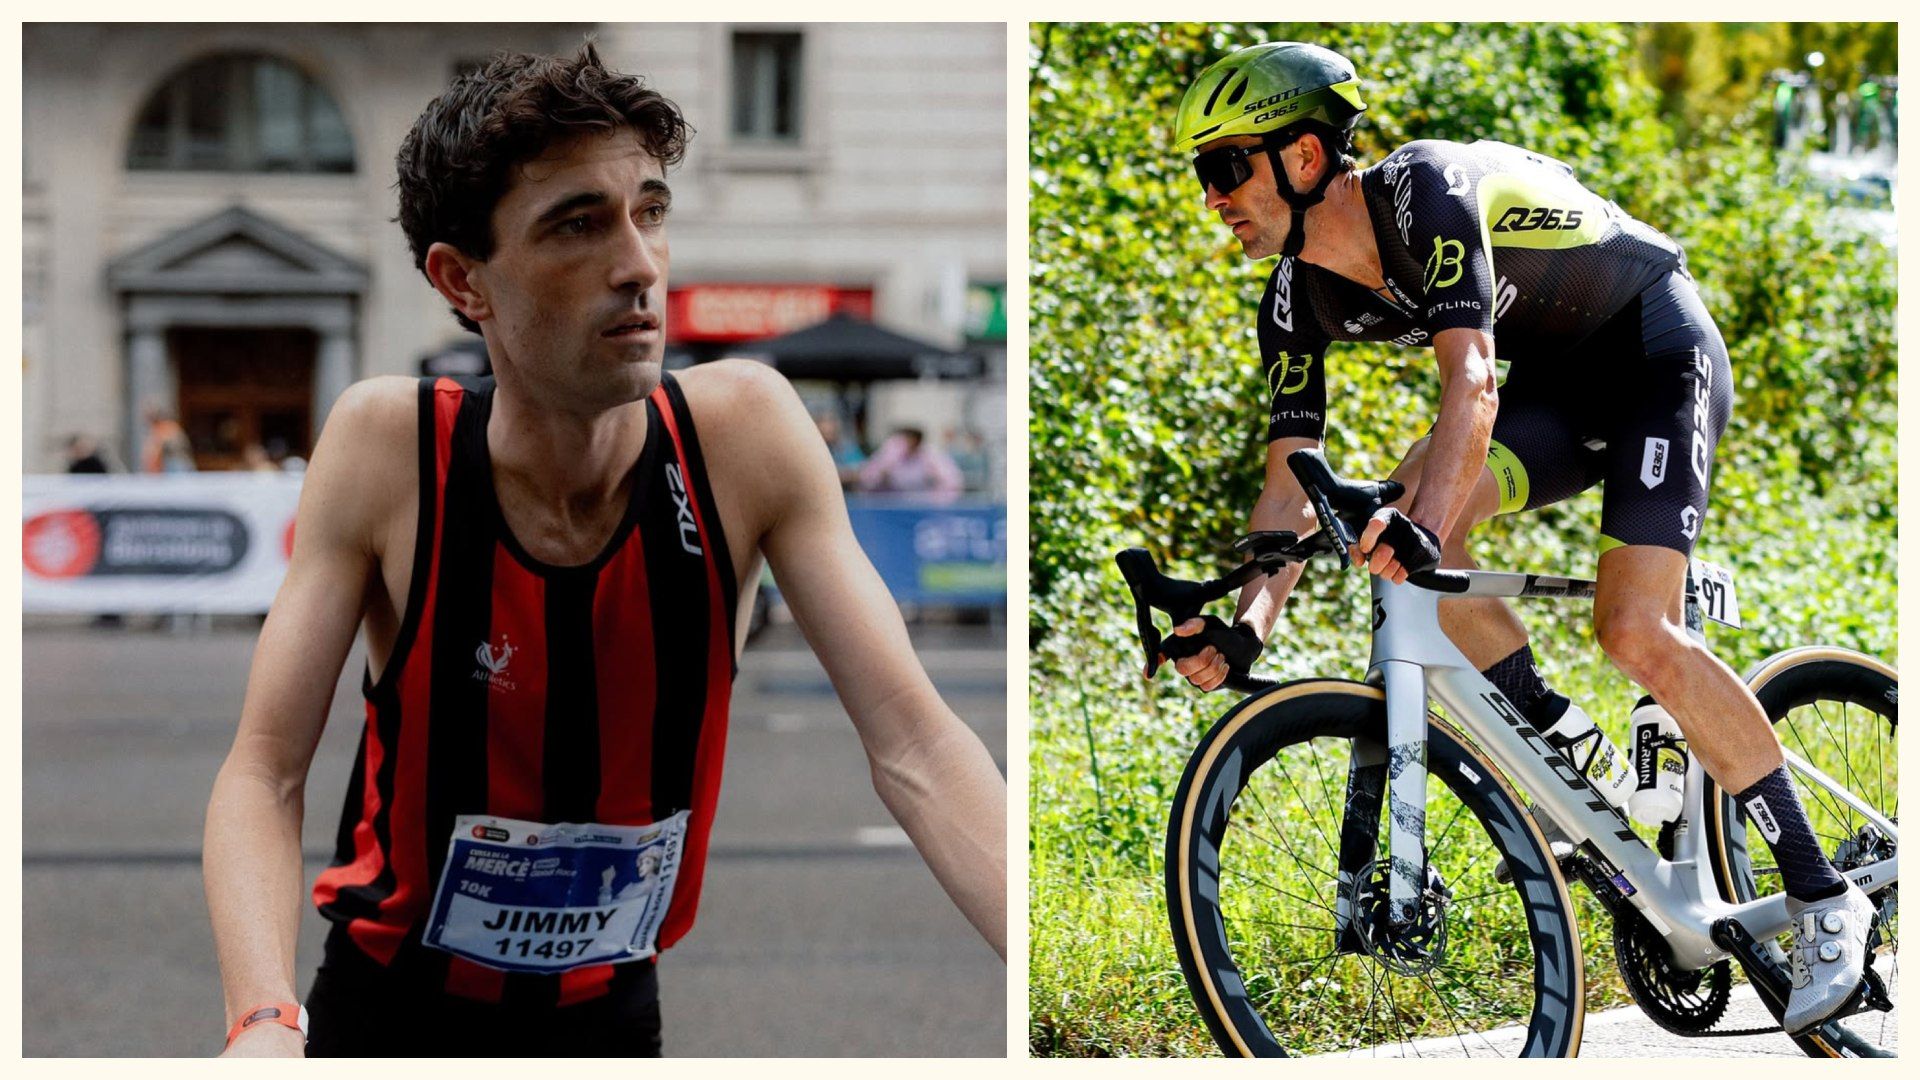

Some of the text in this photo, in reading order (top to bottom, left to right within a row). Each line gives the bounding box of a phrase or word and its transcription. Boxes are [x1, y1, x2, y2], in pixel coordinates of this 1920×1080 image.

[1243, 87, 1302, 115] SCOTT
[1254, 102, 1299, 124] Q36.5
[1492, 206, 1583, 233] Q36.5
[1691, 345, 1713, 491] Q36.5
[1652, 442, 1669, 478] Q36.5
[664, 462, 703, 556] 2XU
[1701, 577, 1726, 621] 97
[471, 670, 517, 691] Athletics
[1641, 729, 1652, 784] GRMIN
[1479, 692, 1649, 849] SCOTT
[464, 856, 532, 878] MERCÈ
[460, 880, 493, 898] 10K
[482, 908, 618, 935] JIMMY
[495, 938, 595, 960] 11497
